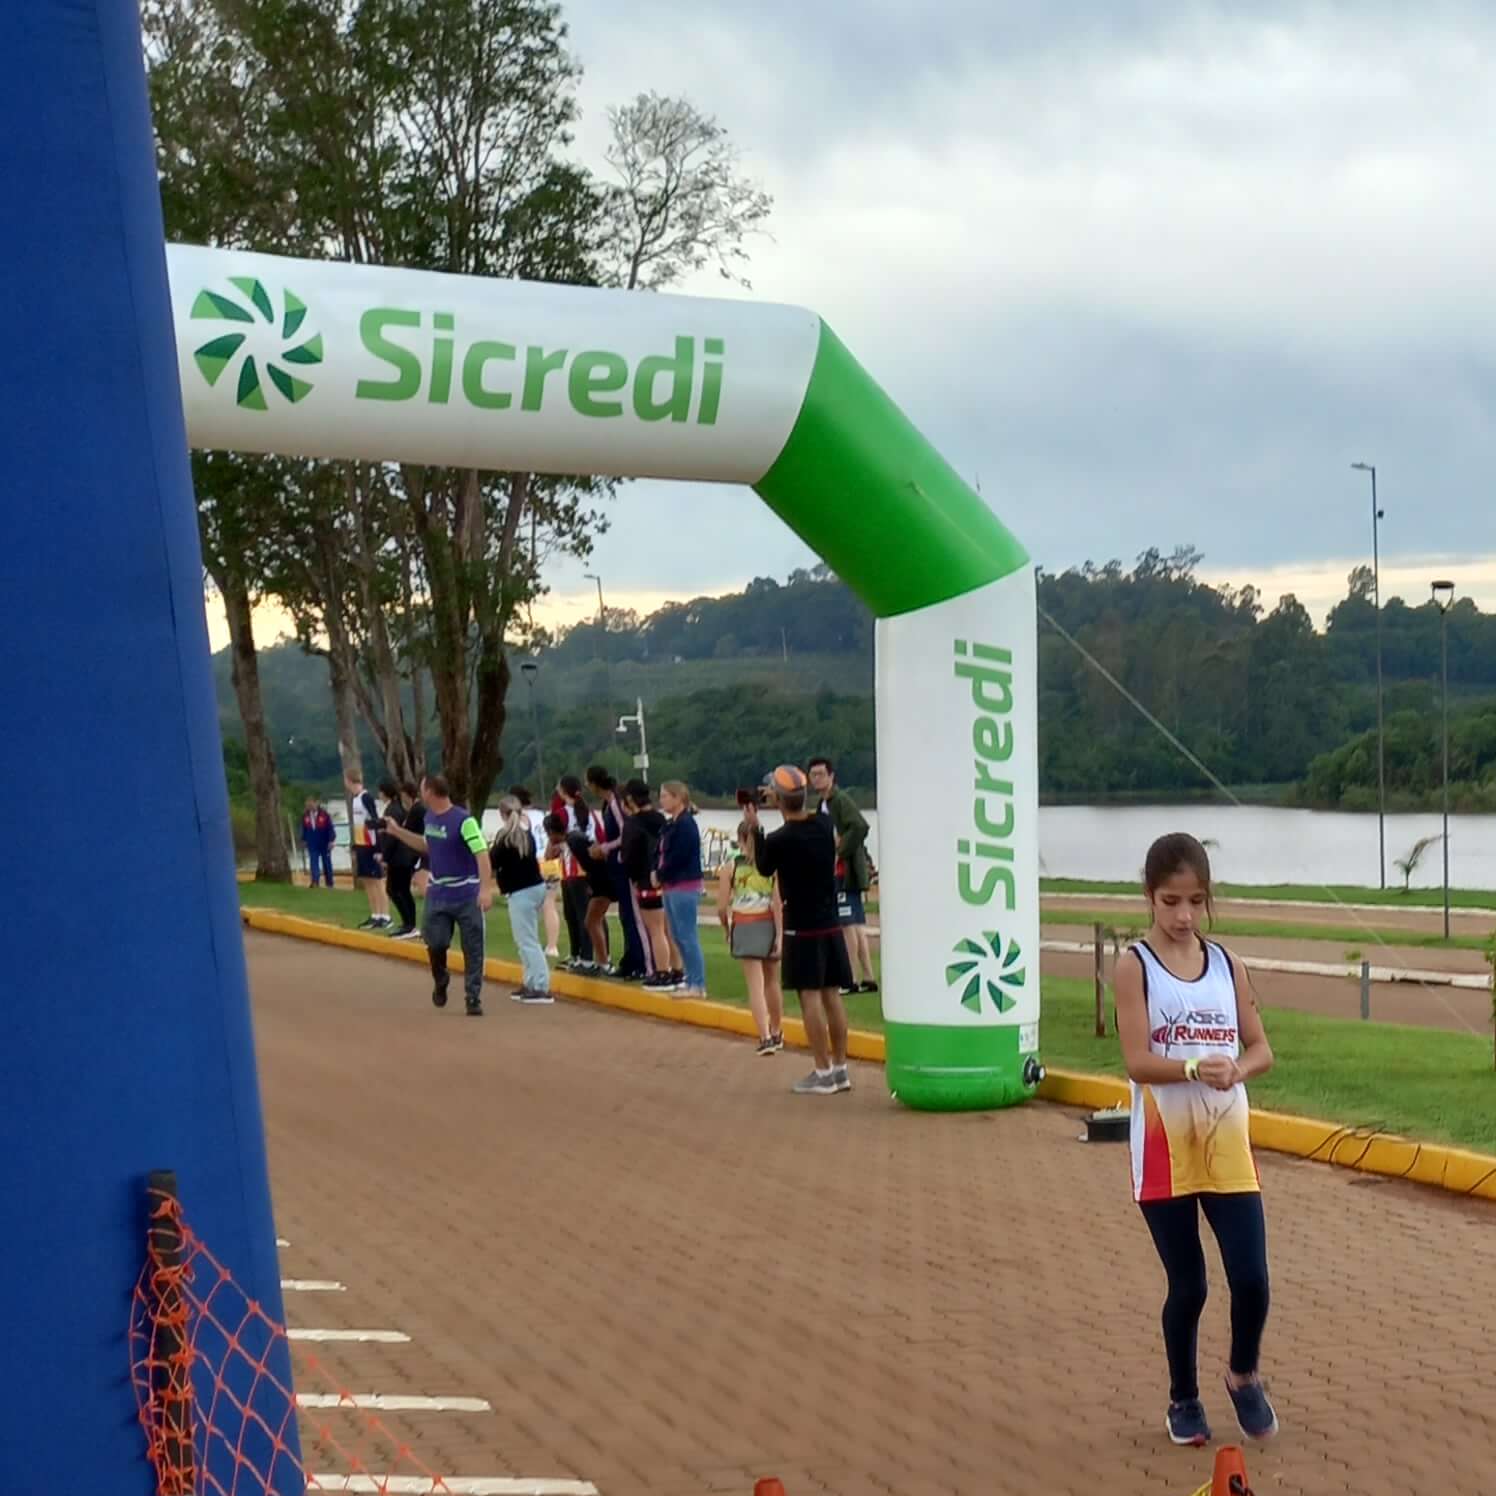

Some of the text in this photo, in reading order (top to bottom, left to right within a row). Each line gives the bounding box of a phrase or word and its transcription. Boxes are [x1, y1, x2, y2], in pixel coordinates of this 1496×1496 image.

[355, 307, 725, 425] Sicredi
[954, 638, 1016, 912] Sicredi
[1174, 1026, 1236, 1043] RUNNERS
